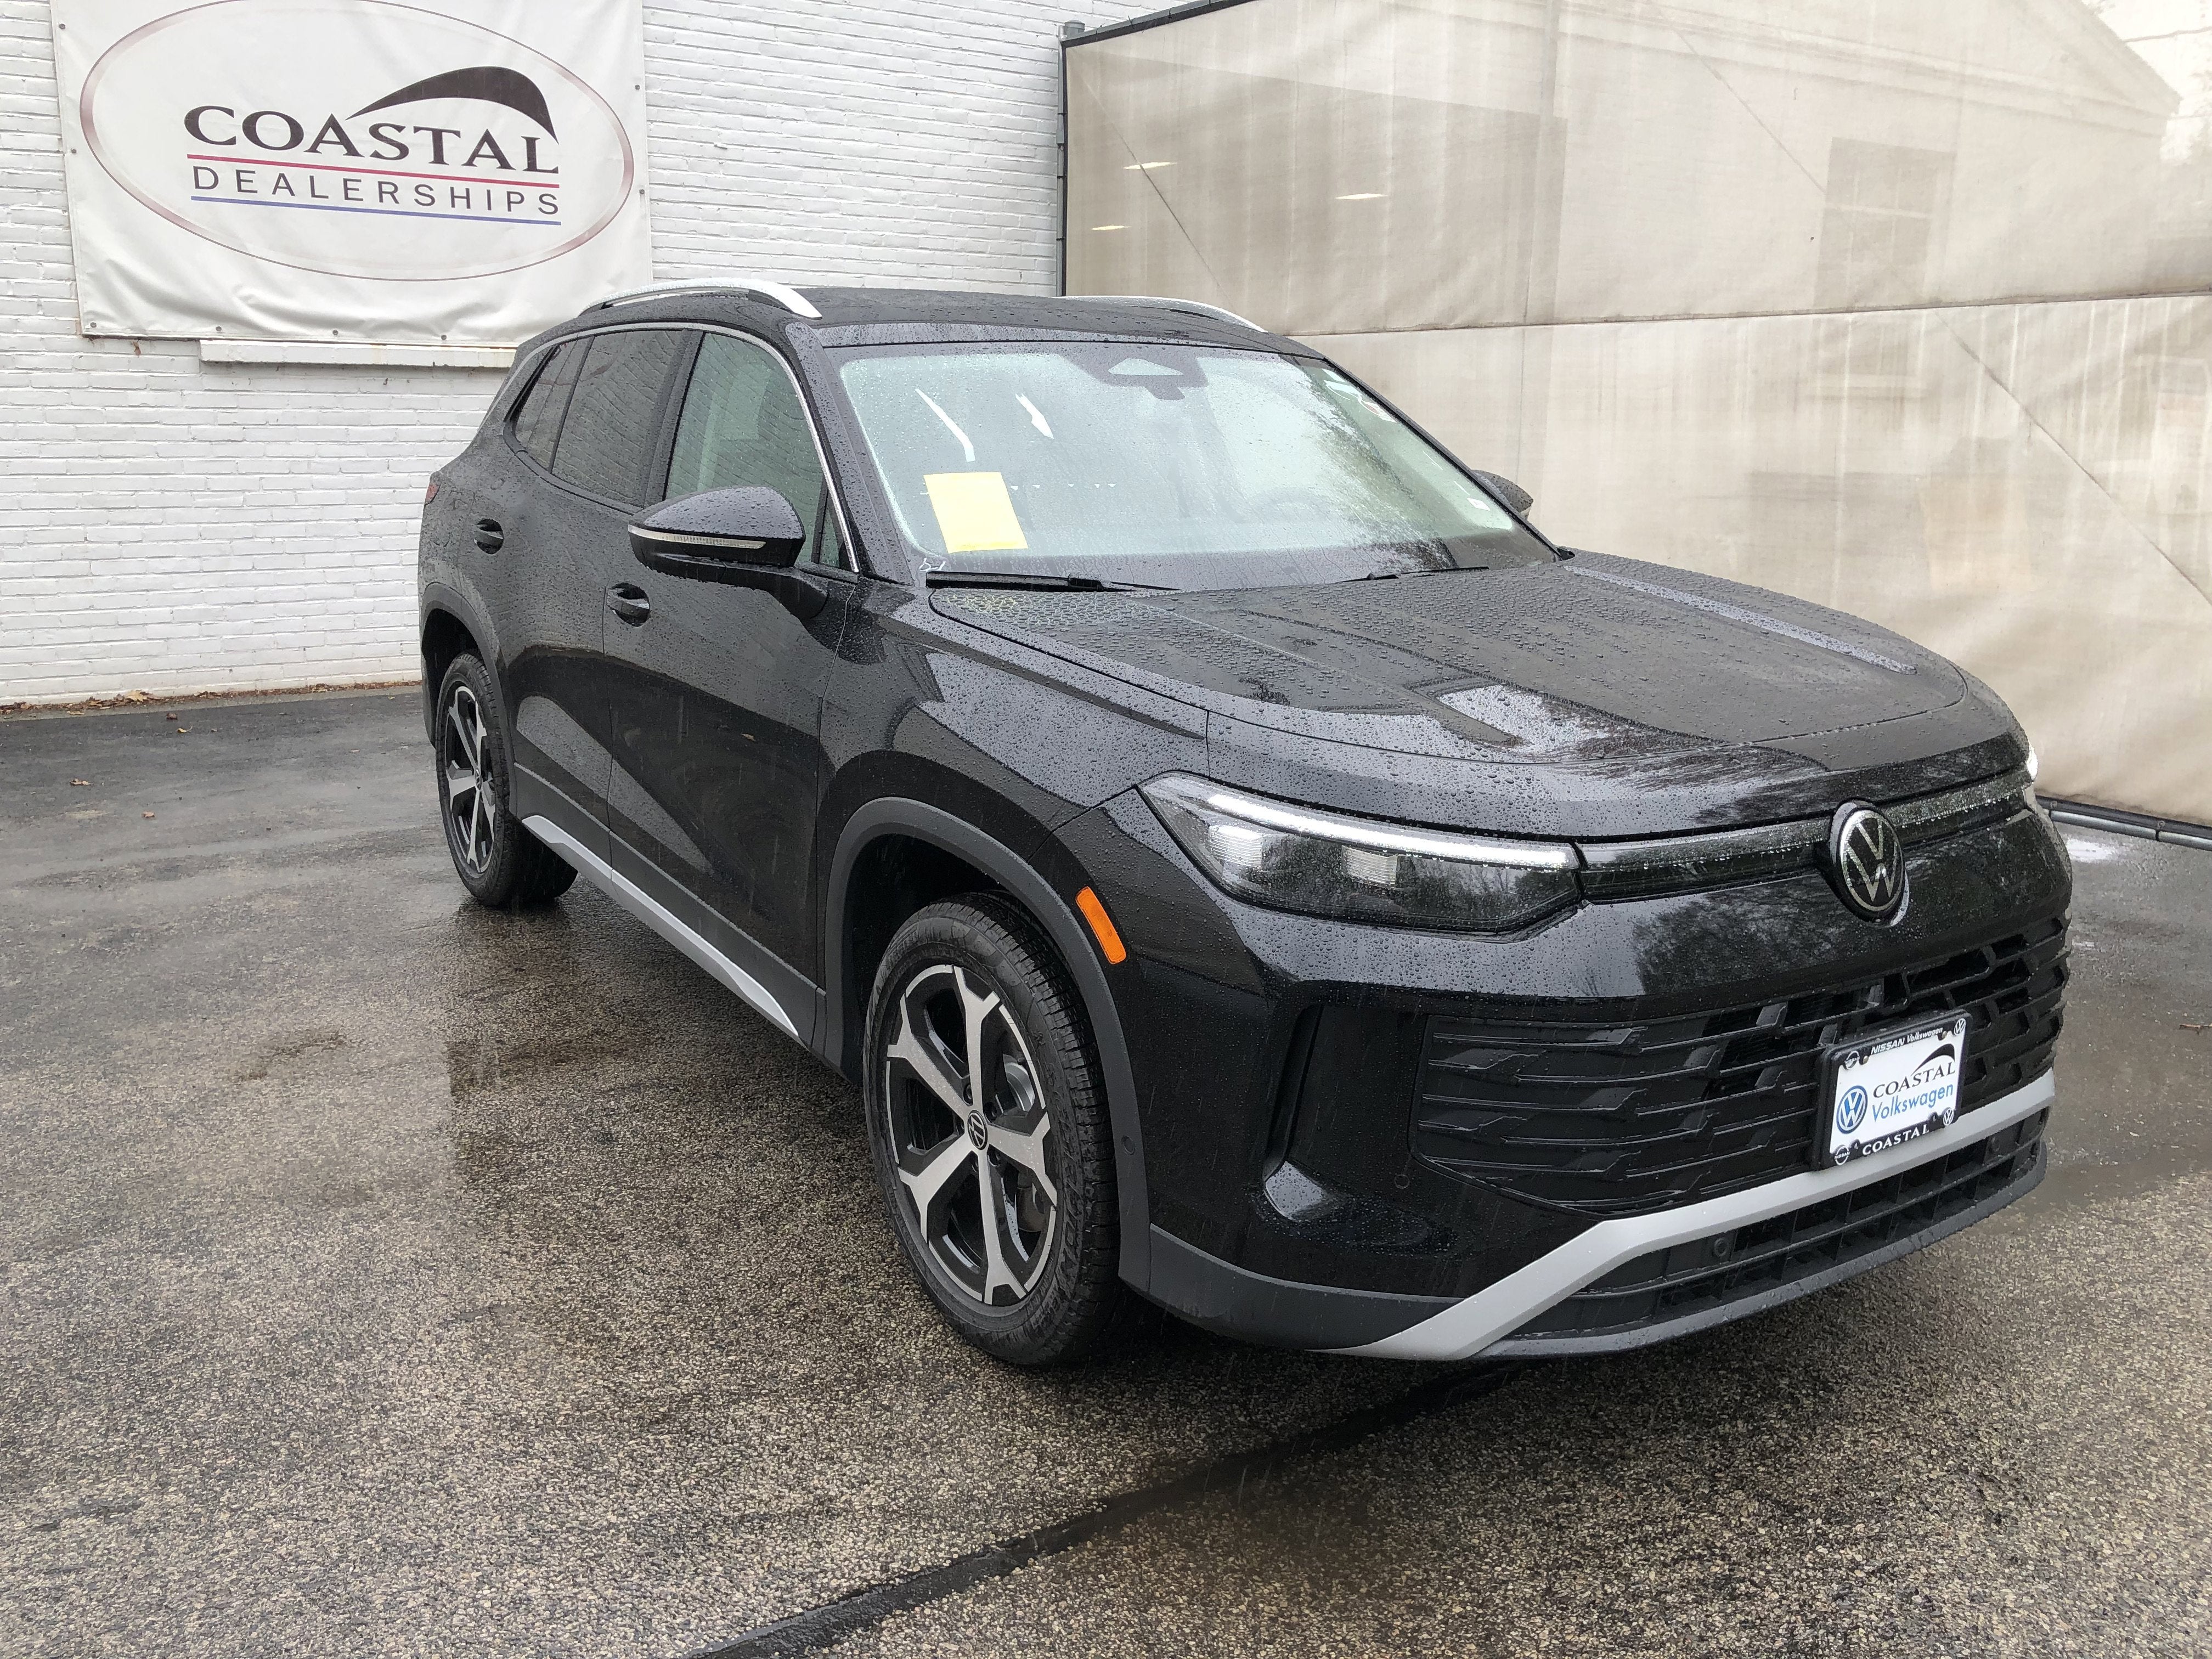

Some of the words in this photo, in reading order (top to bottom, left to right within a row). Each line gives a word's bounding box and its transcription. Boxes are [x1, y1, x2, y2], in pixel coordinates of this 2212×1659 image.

[184, 106, 560, 174] COASTAL
[193, 166, 559, 215] DEALERSHIPS
[1871, 1037, 1905, 1055] NISSAN
[1907, 1027, 1943, 1043] Volkswagen
[1873, 1062, 1956, 1098] COASTAL
[1872, 1084, 1954, 1122] Volkswagen
[1863, 1124, 1929, 1156] COASTAL
